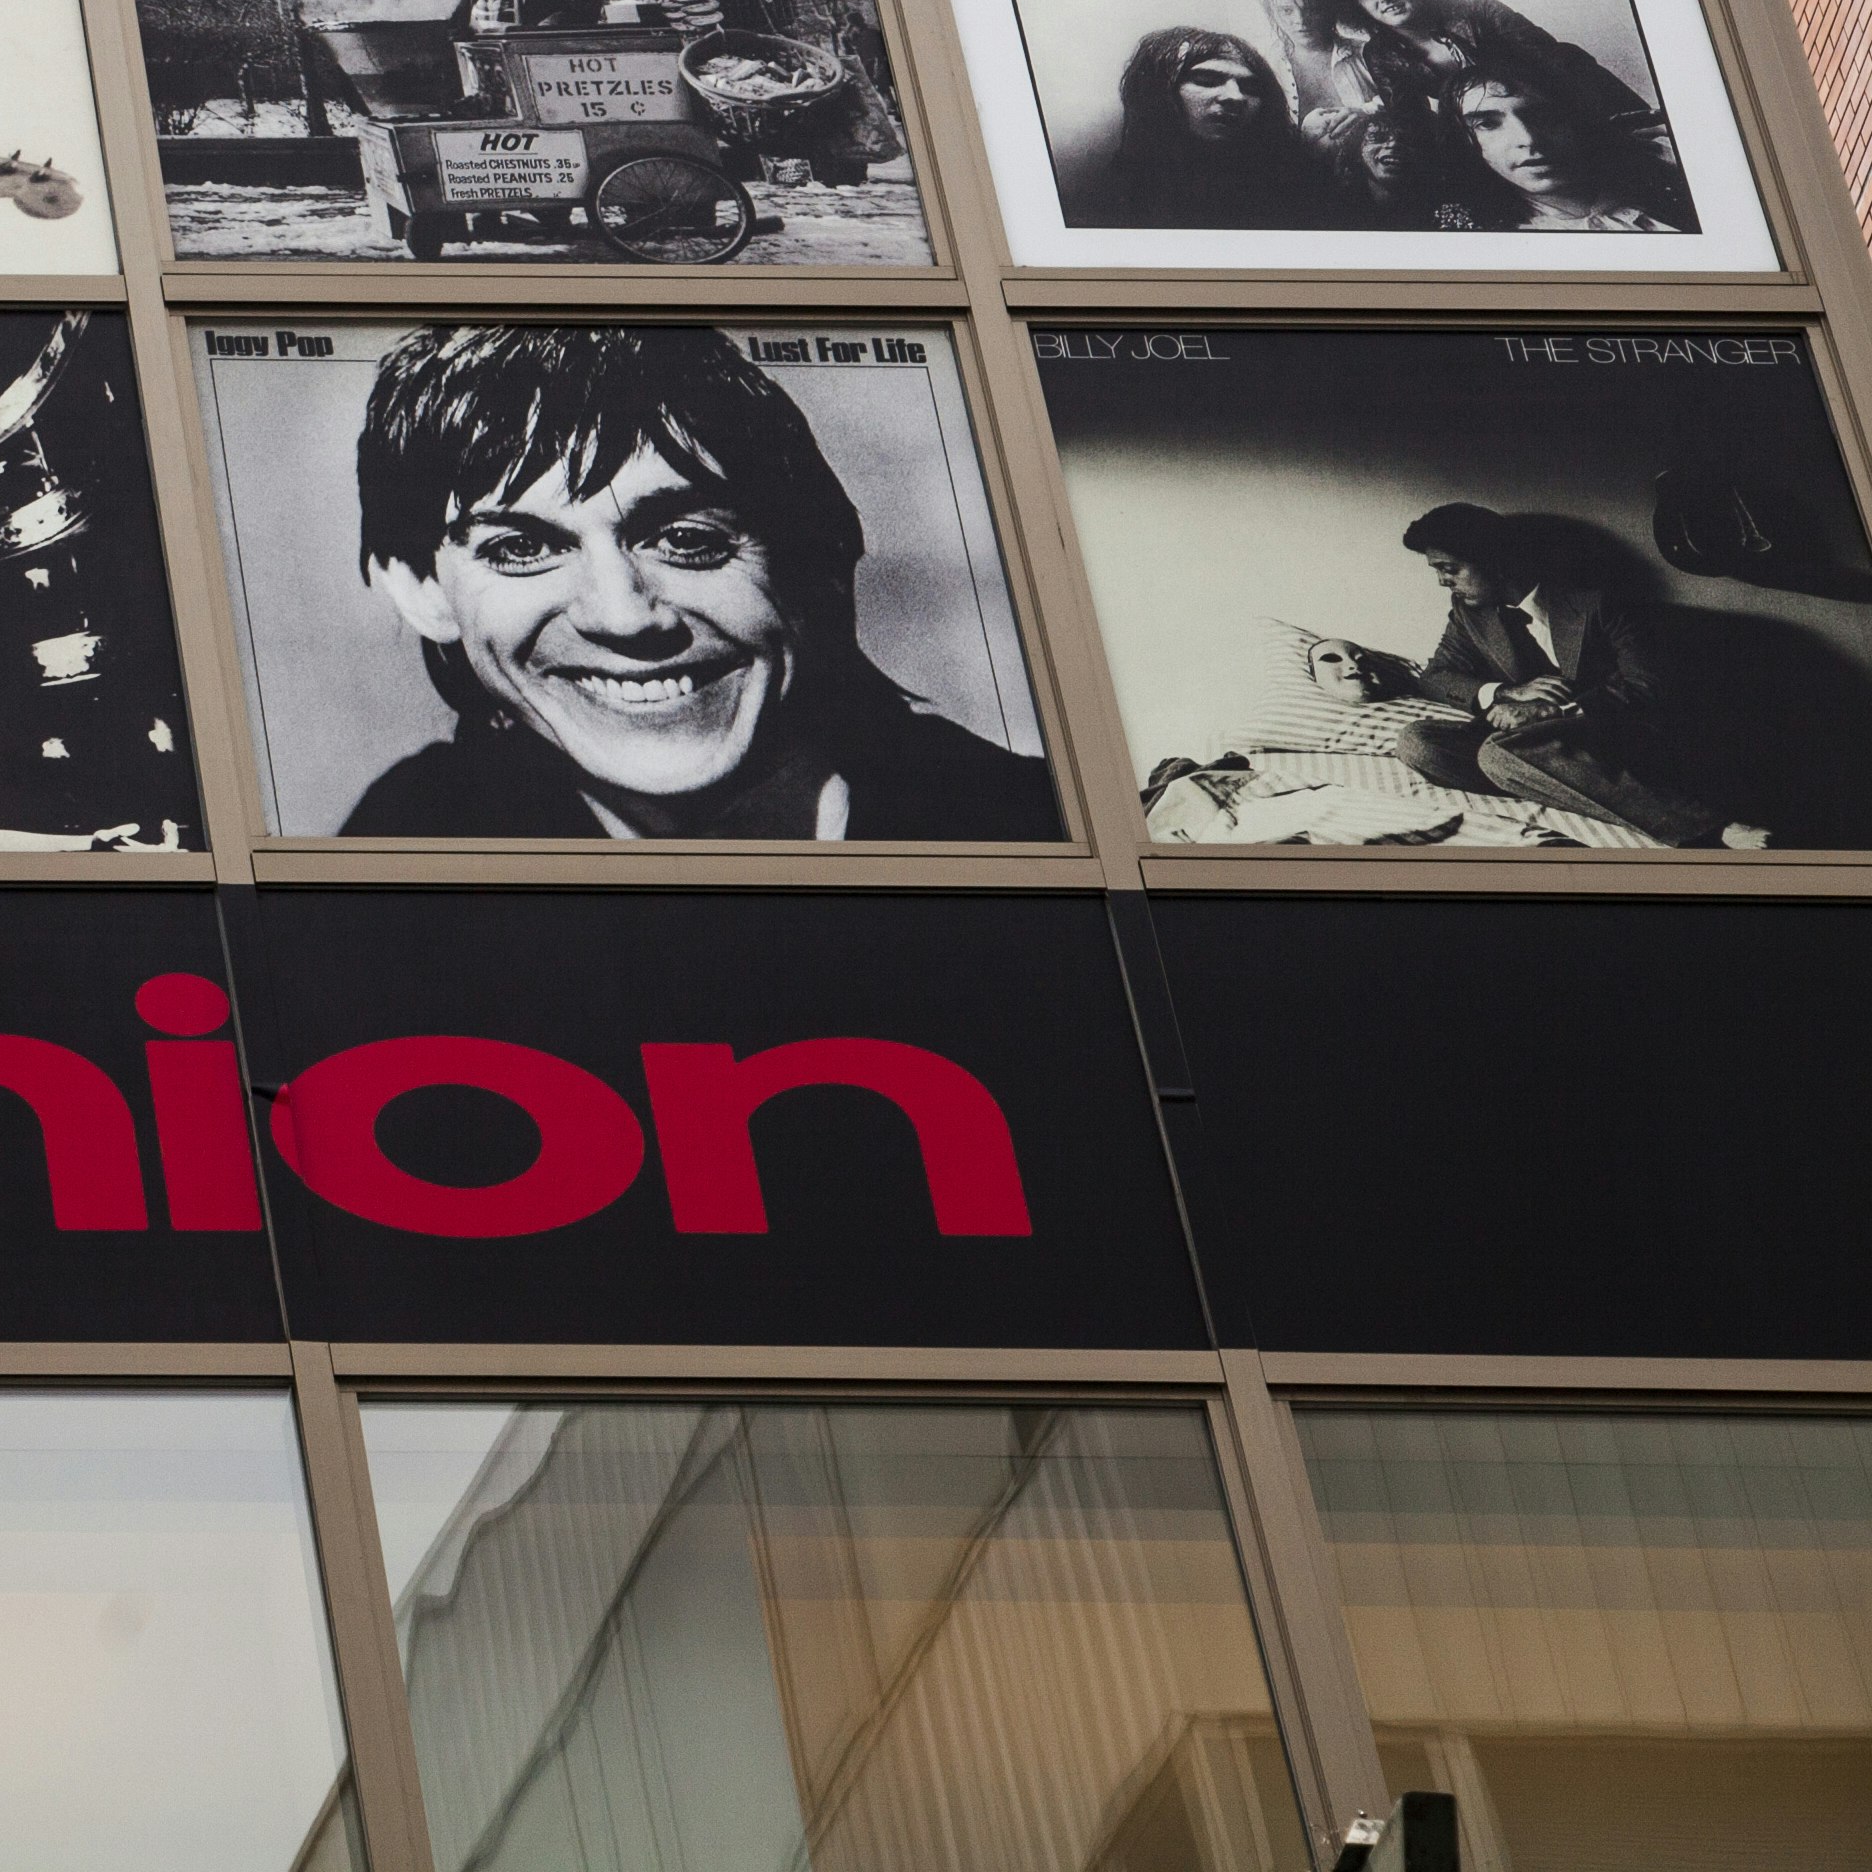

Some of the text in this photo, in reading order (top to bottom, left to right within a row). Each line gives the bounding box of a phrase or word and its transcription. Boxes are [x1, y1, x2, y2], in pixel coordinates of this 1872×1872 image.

[569, 57, 617, 73] HOT
[537, 79, 673, 97] PRETZLES
[580, 101, 607, 117] 15
[480, 132, 540, 152] HOT
[445, 159, 488, 170] Roasted
[488, 158, 551, 170] CHESTNUTS
[448, 173, 491, 184] Roasted
[493, 172, 553, 184] PEANUTS
[450, 187, 479, 199] Fresh
[479, 186, 534, 199] PRETZELS
[205, 331, 333, 357] Iggy Pop
[749, 335, 928, 365] Lust For Life
[1034, 335, 1230, 359] BILLY JOEL
[1495, 338, 1800, 364] THE STRANGER
